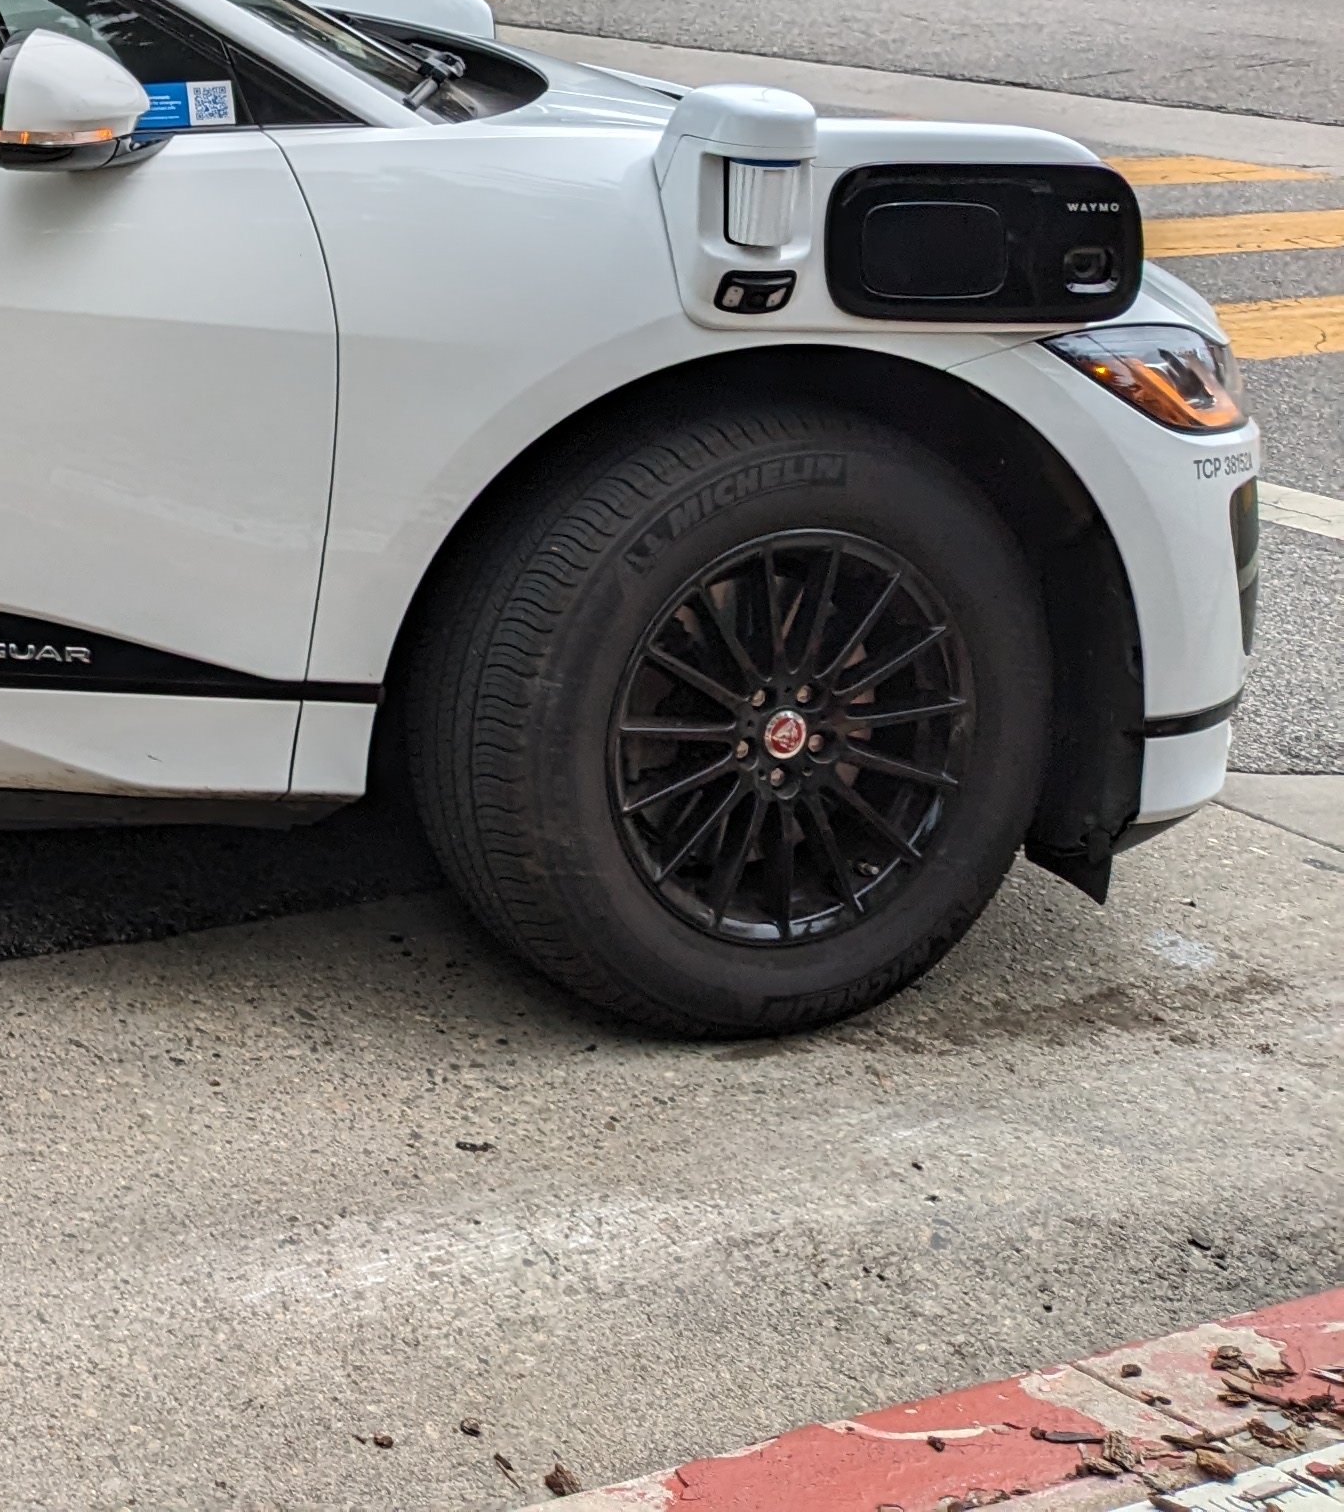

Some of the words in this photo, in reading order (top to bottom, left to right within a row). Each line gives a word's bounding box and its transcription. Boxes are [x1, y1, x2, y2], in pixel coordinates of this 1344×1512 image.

[1066, 202, 1120, 212] WAYMO
[1193, 457, 1221, 479] TCP
[667, 455, 845, 539] MICHELIN
